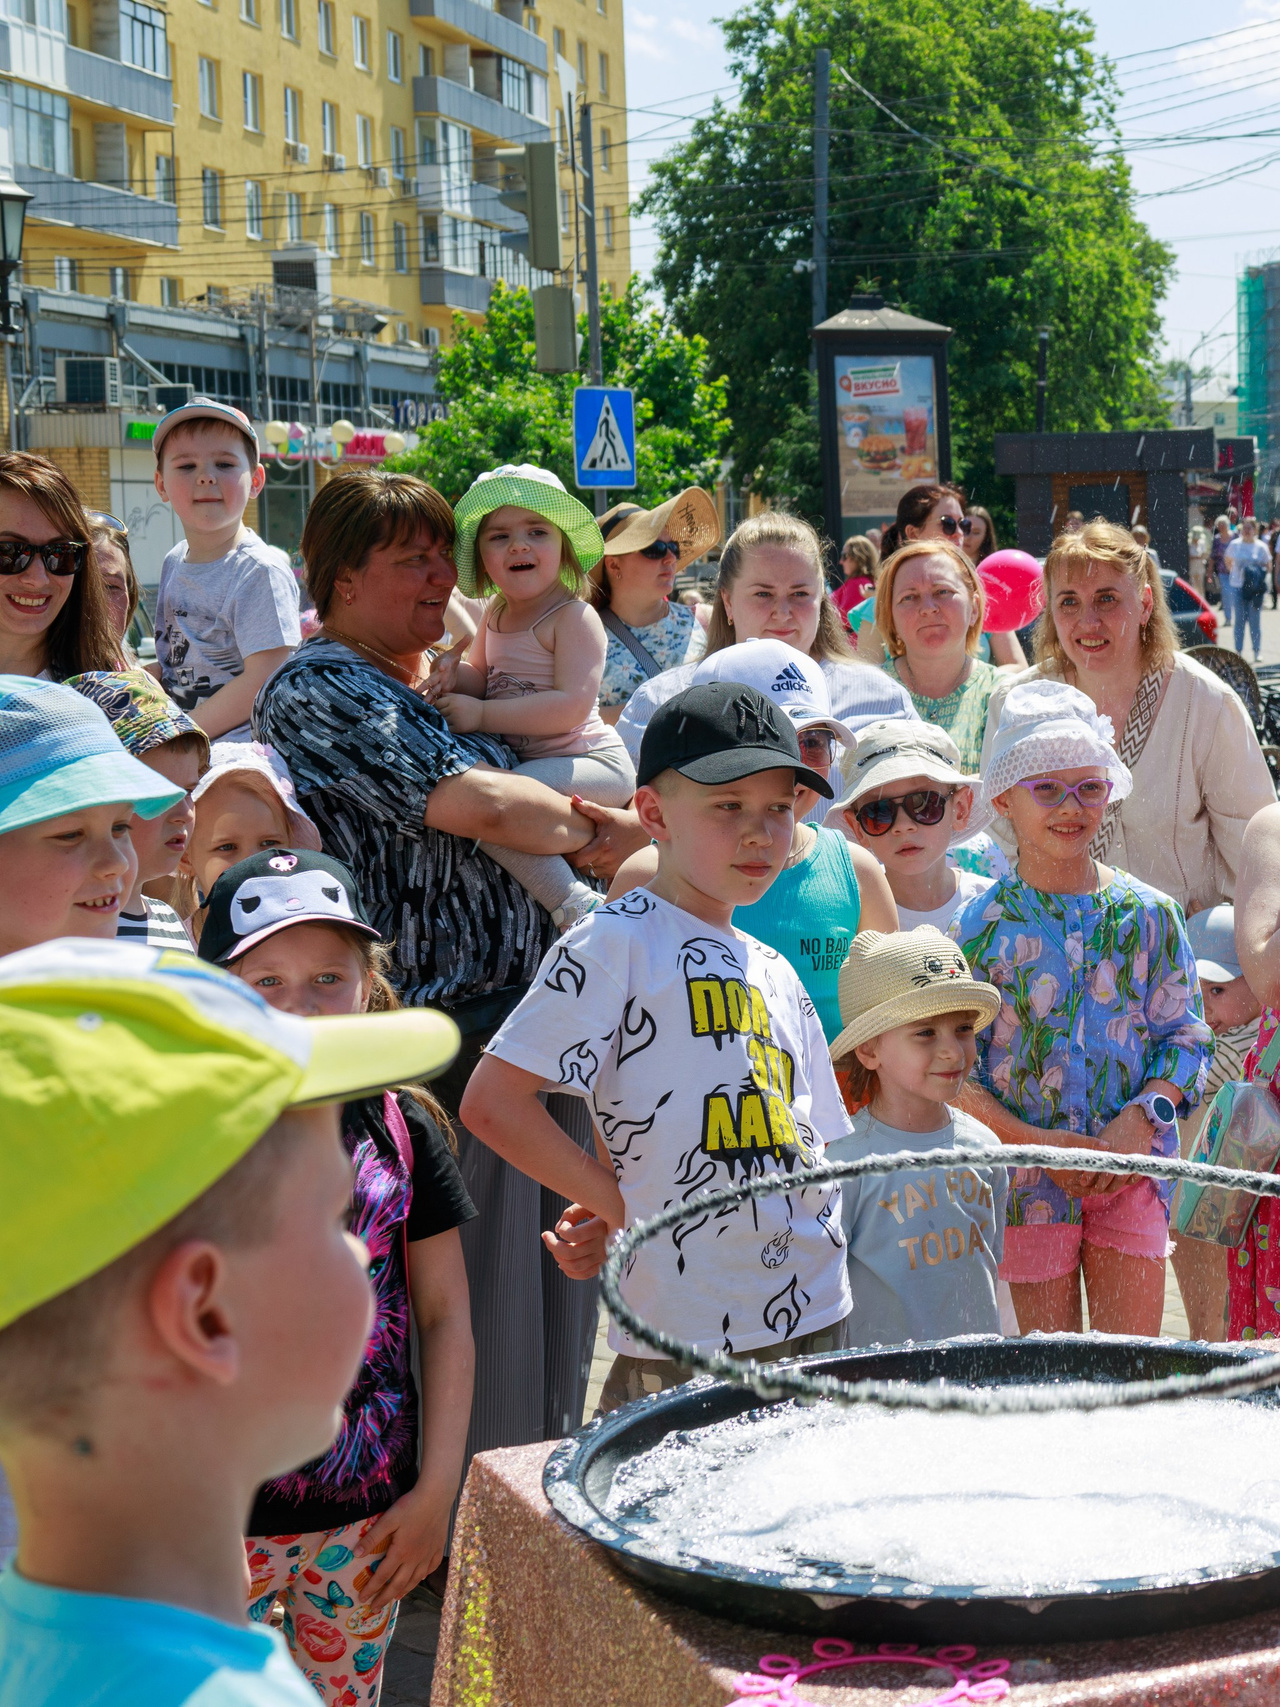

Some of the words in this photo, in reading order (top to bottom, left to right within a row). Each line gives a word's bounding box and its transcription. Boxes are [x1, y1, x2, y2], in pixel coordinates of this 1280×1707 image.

[854, 378, 897, 391] ВКУСНО
[771, 680, 813, 694] adidas
[800, 938, 820, 955] NO
[826, 937, 849, 954] BAD
[811, 954, 846, 971] VIBES
[686, 977, 772, 1037] ПОЛ
[878, 1174, 938, 1224] YAY
